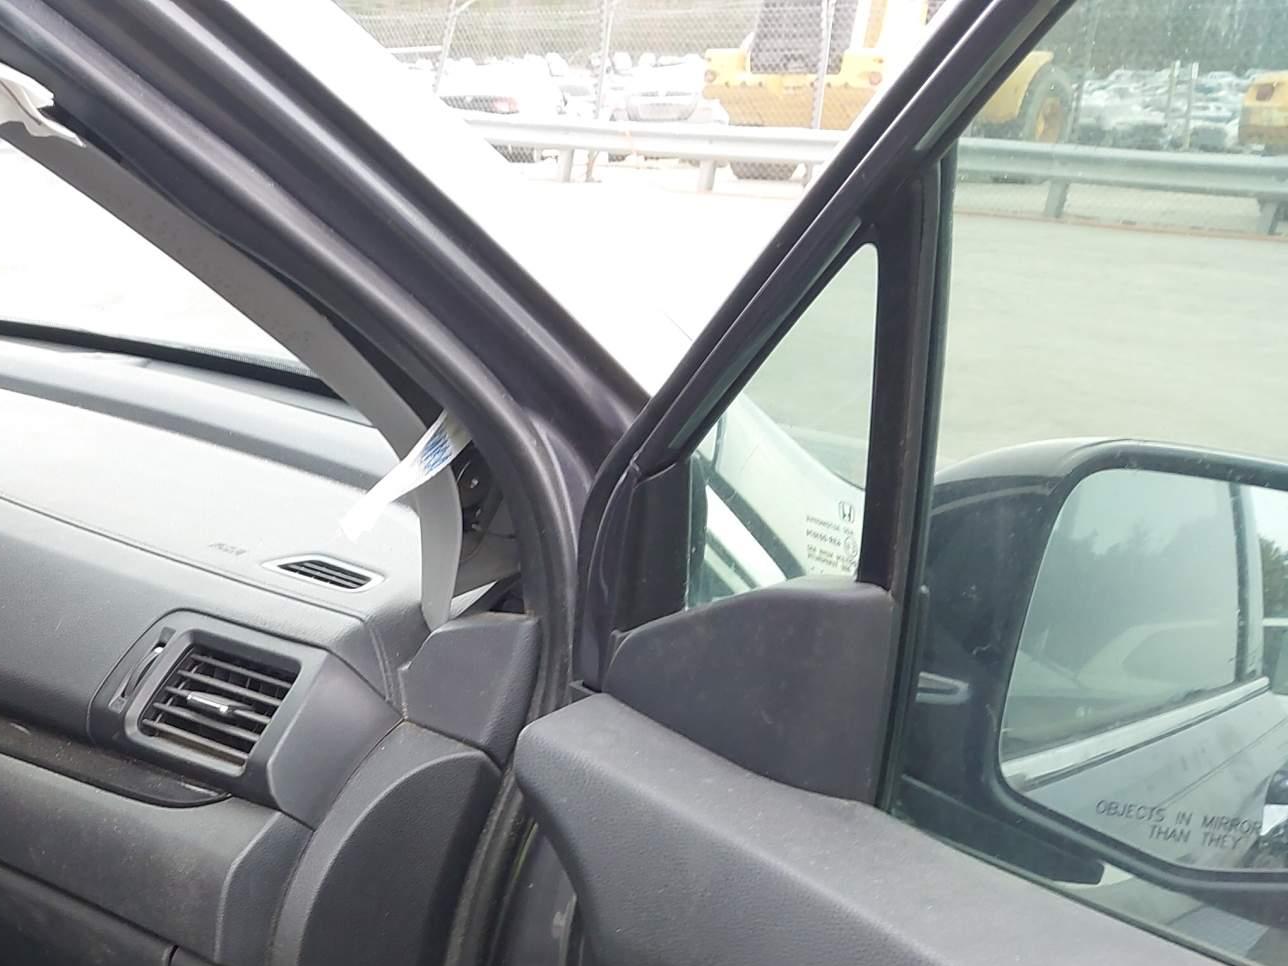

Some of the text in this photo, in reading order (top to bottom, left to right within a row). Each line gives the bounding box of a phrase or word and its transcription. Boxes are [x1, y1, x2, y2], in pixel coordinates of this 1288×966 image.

[1095, 799, 1262, 836] OBJECTS IN MIRROR
[1148, 824, 1244, 849] THAN THEY
